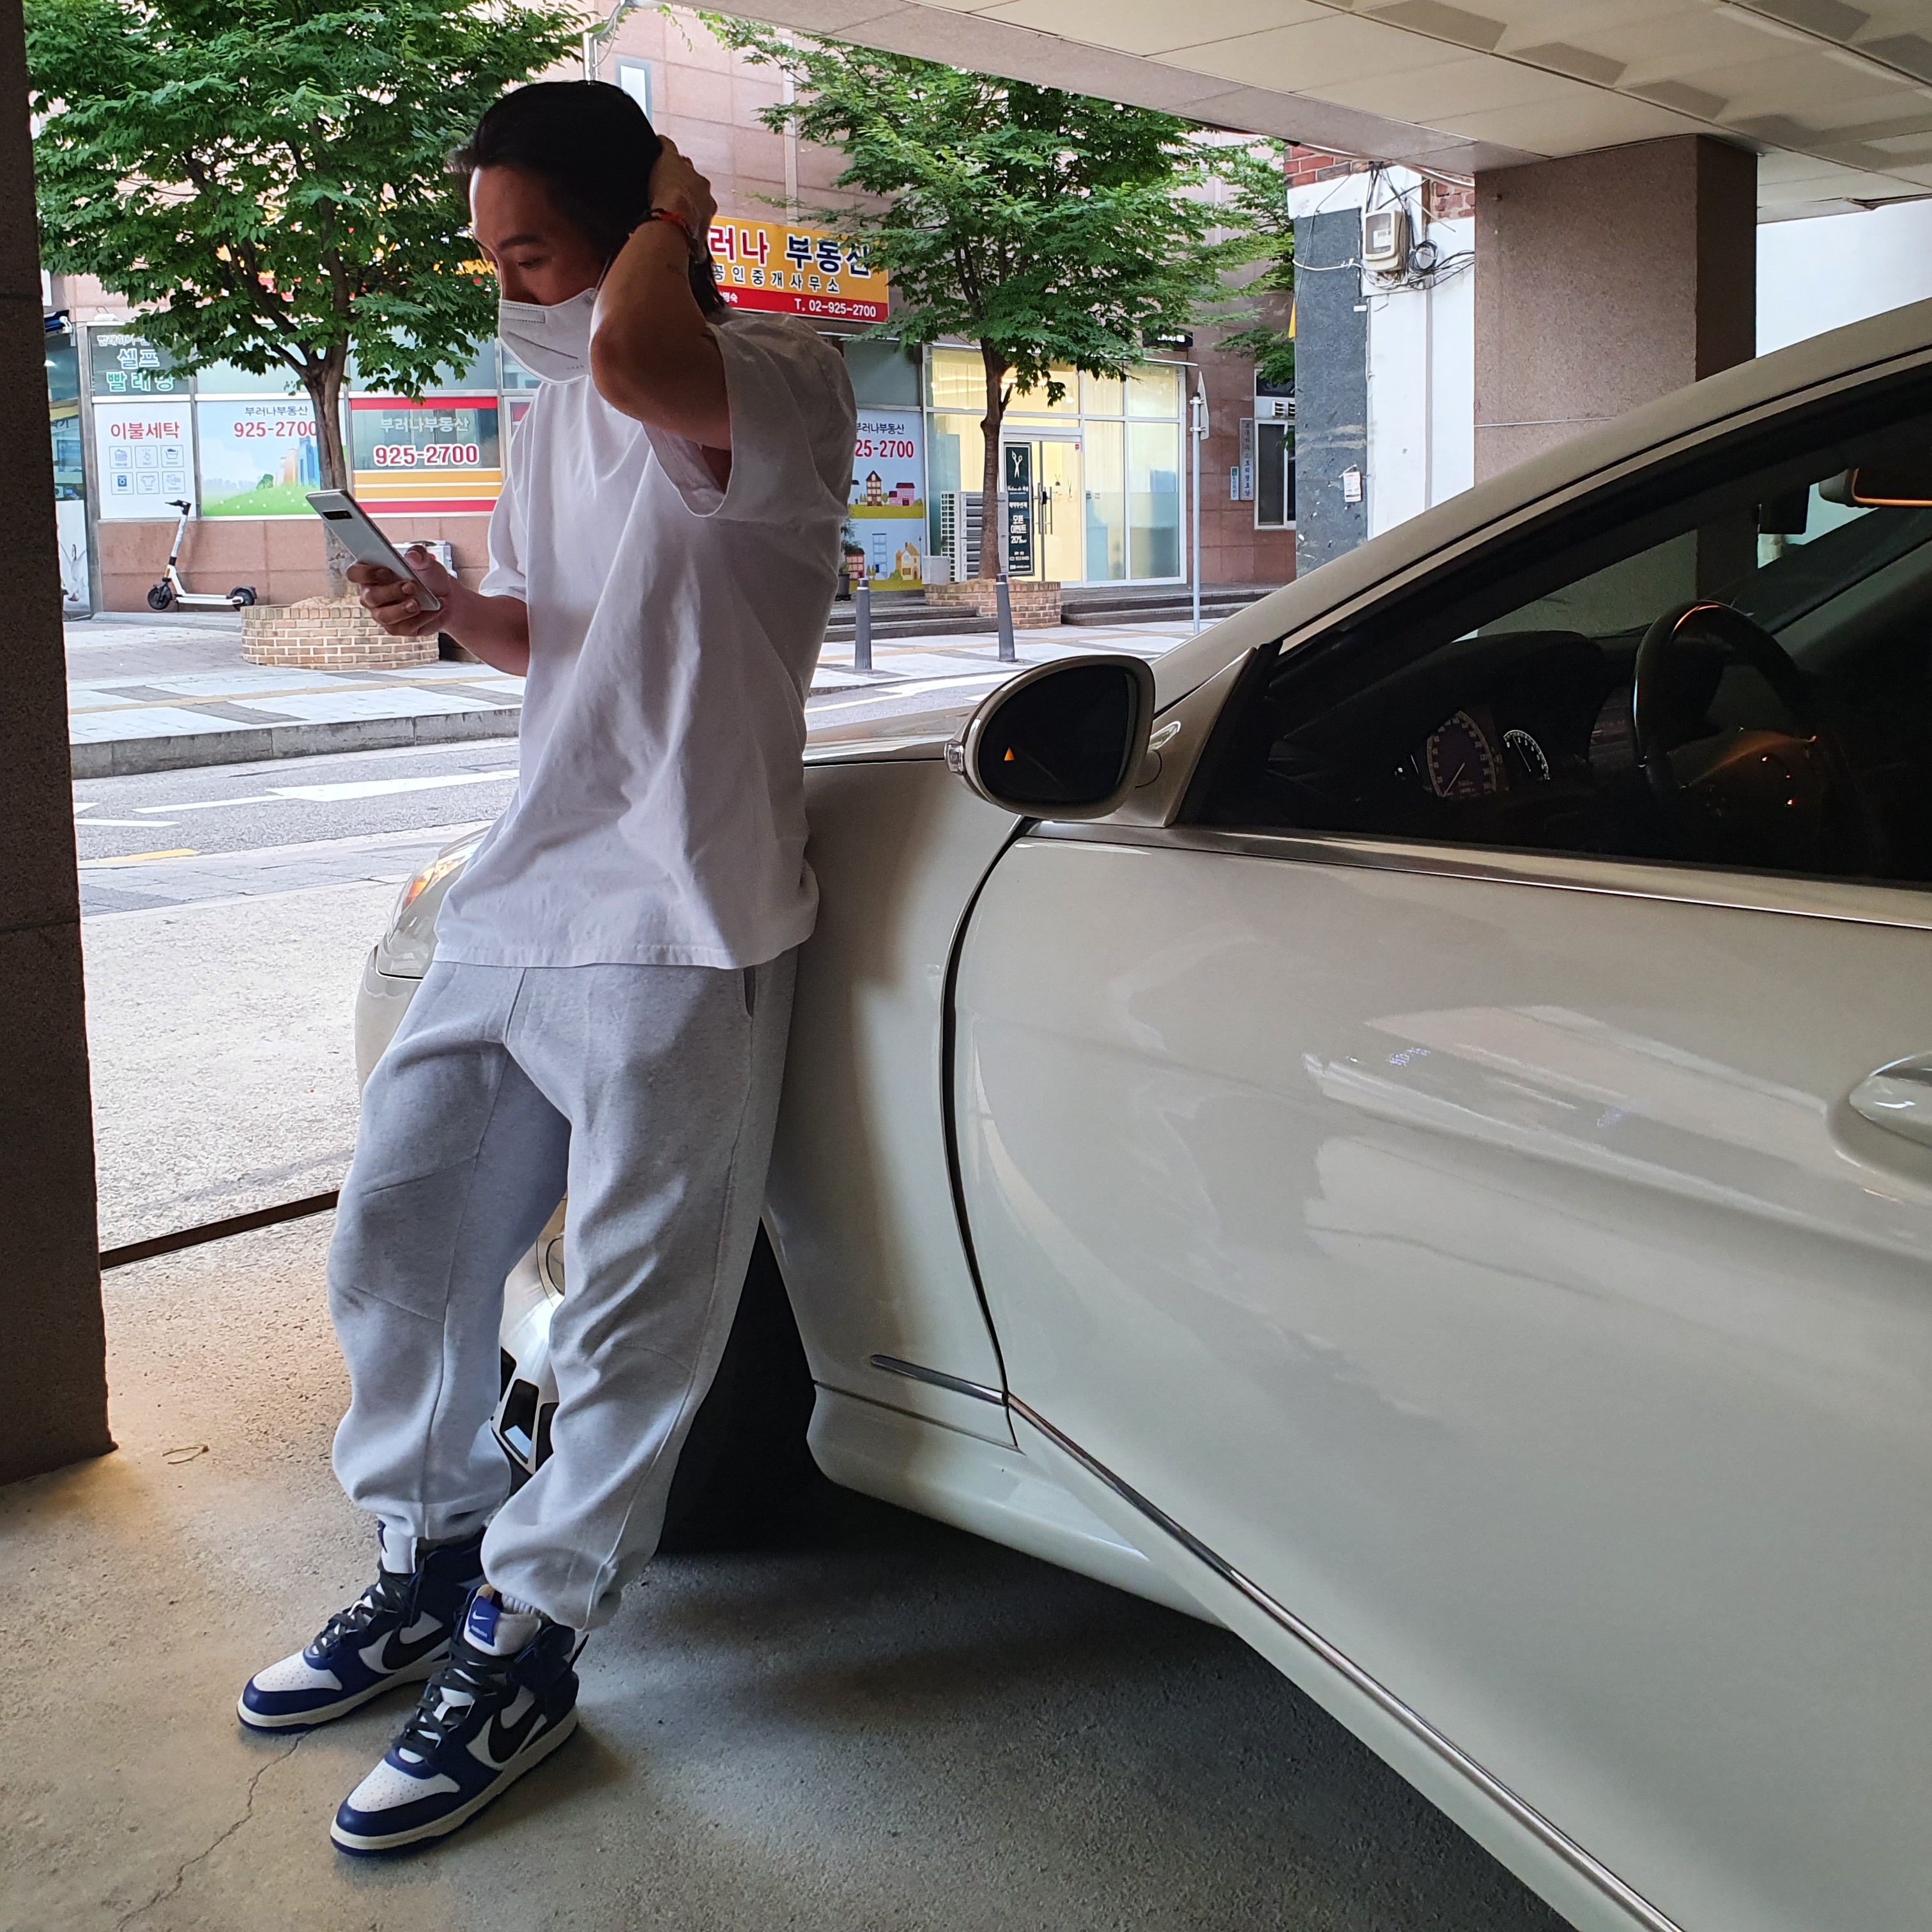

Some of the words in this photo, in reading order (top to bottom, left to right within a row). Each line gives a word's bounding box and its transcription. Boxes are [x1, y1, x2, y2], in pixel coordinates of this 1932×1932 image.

[786, 234, 870, 277] 부동산
[714, 264, 839, 293] 공인중개사무소
[719, 291, 739, 303] 명숙
[794, 298, 806, 312] T.
[808, 300, 877, 318] 02-925-2700
[118, 349, 160, 369] 셀프
[245, 406, 308, 417] 부러나부동산
[111, 421, 180, 440] 이불세탁
[234, 421, 317, 438] 925-2700
[380, 417, 469, 433] 부러나부동산
[374, 444, 479, 466] 925-2700
[1013, 515, 1024, 525] 오픈
